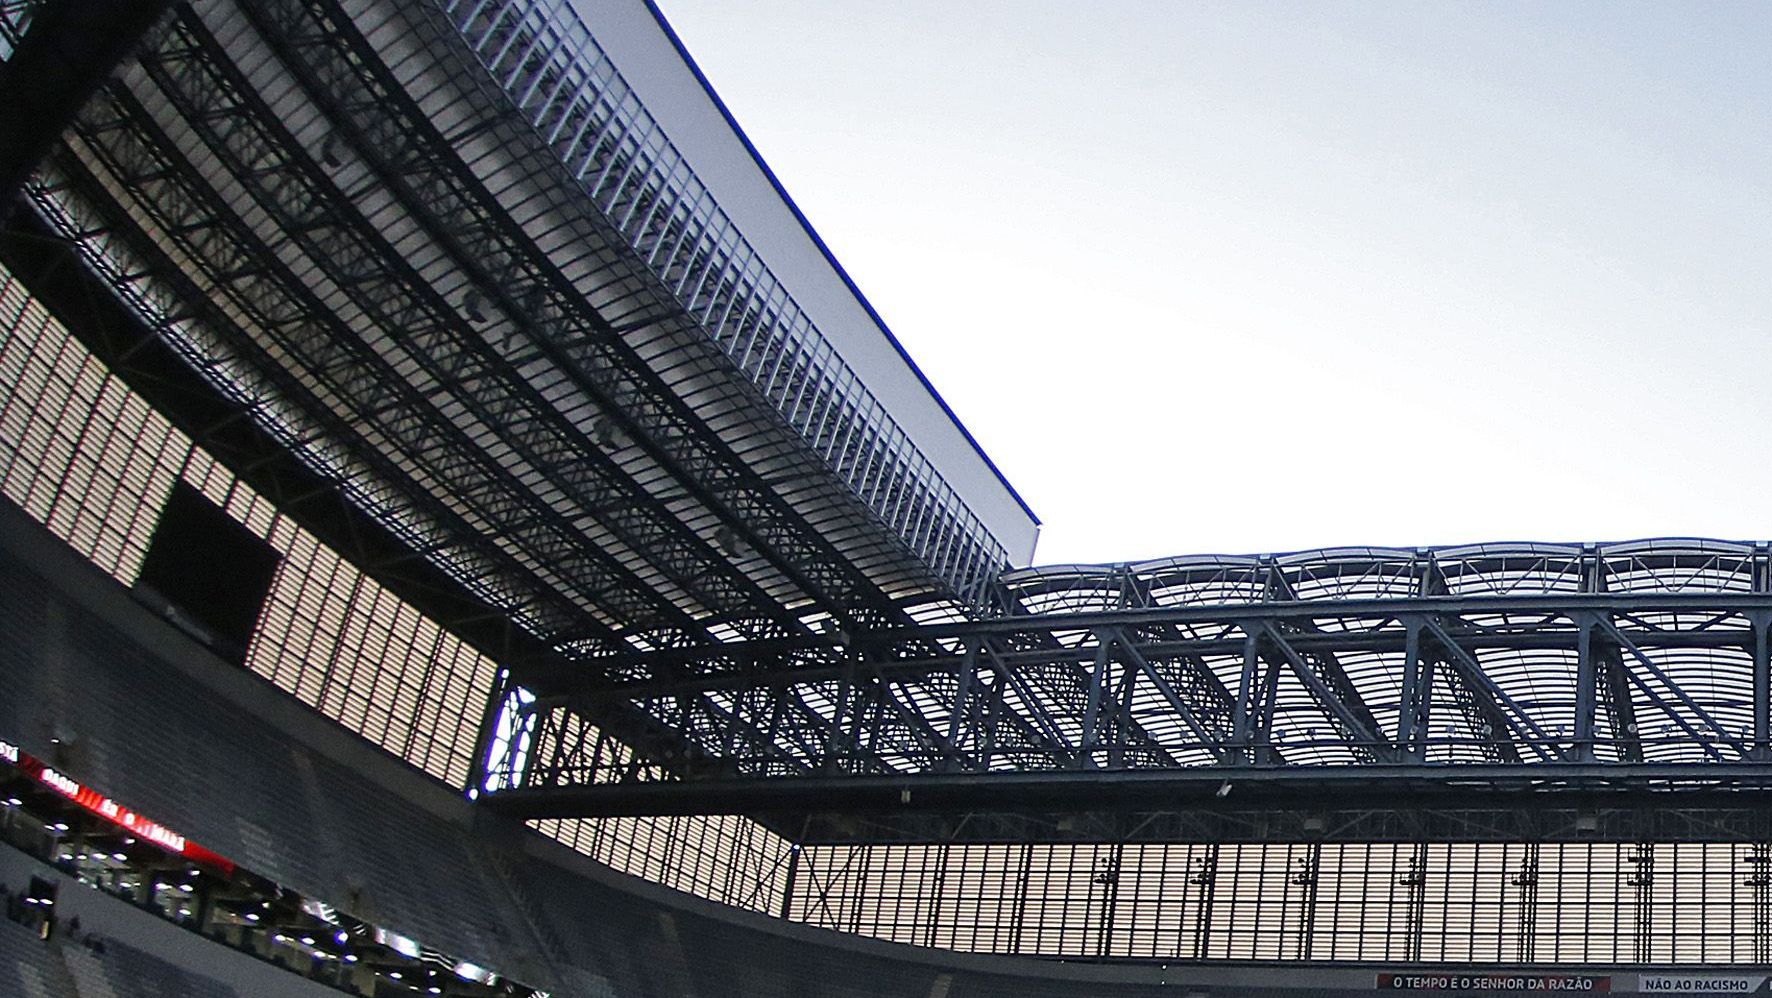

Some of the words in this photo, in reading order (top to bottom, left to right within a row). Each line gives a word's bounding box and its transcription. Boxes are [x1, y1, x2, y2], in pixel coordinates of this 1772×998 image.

[1393, 976, 1403, 988] O
[1406, 977, 1448, 988] TEMPO
[1450, 975, 1458, 989] É
[1461, 977, 1470, 989] O
[1473, 978, 1524, 990] SENHOR
[1527, 978, 1545, 990] DA
[1548, 976, 1593, 990] RAZÃO
[1645, 977, 1672, 991] NÃO
[1674, 980, 1692, 990] AO
[1694, 980, 1748, 991] RACISMO
